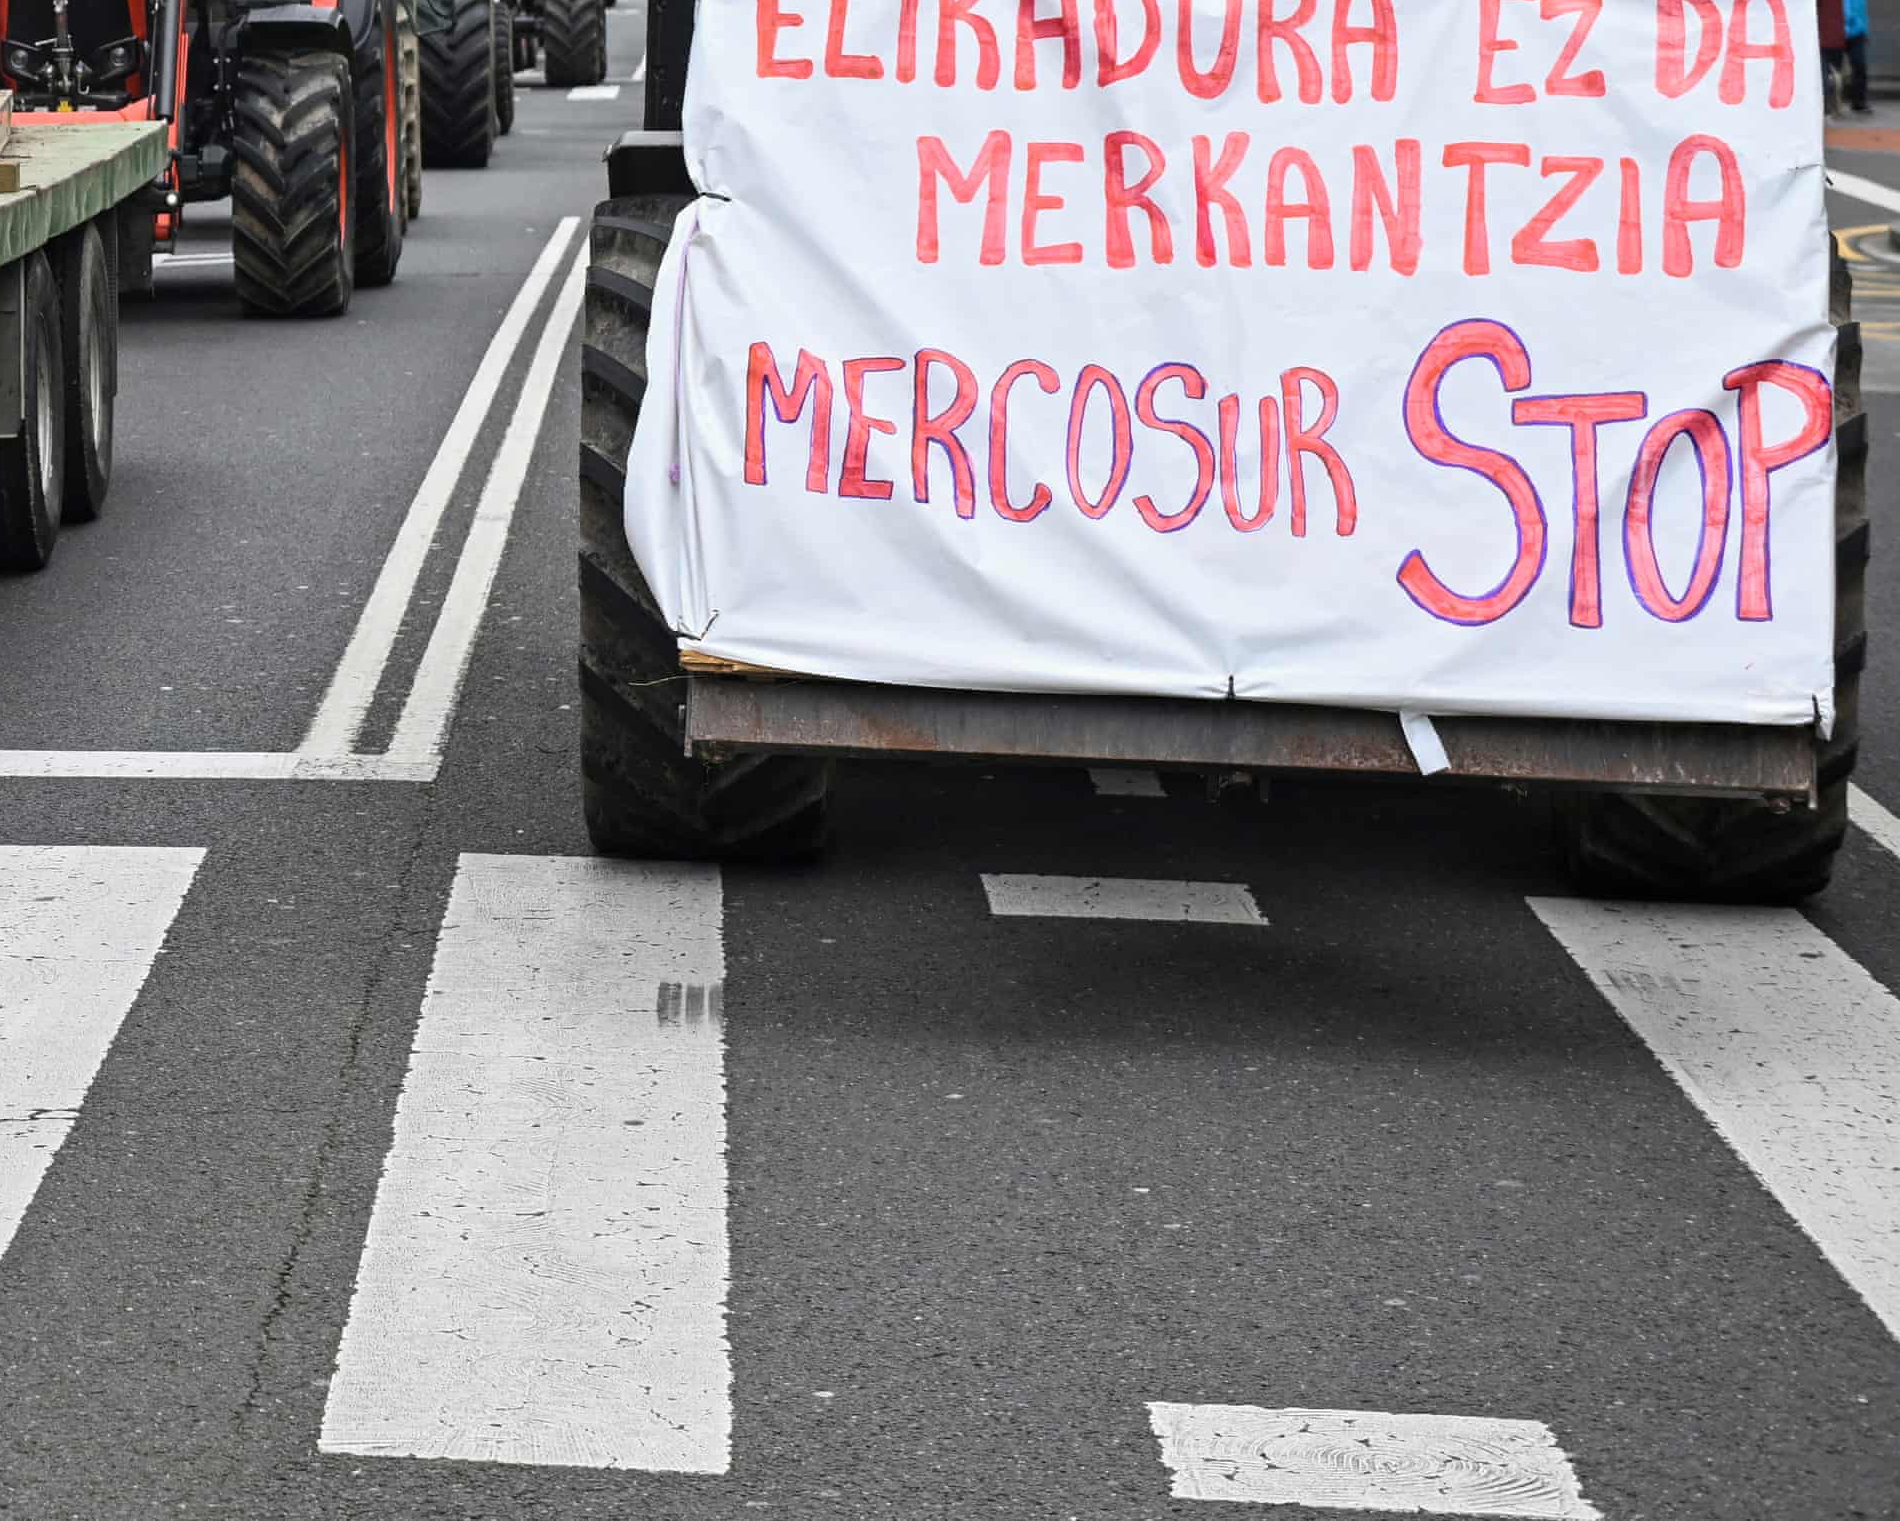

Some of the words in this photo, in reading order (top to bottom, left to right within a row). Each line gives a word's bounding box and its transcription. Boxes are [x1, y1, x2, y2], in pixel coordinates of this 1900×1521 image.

[917, 130, 1745, 278] MERKANTZIA
[745, 343, 1357, 536] MERCOSUR
[1396, 319, 1833, 629] STOP
